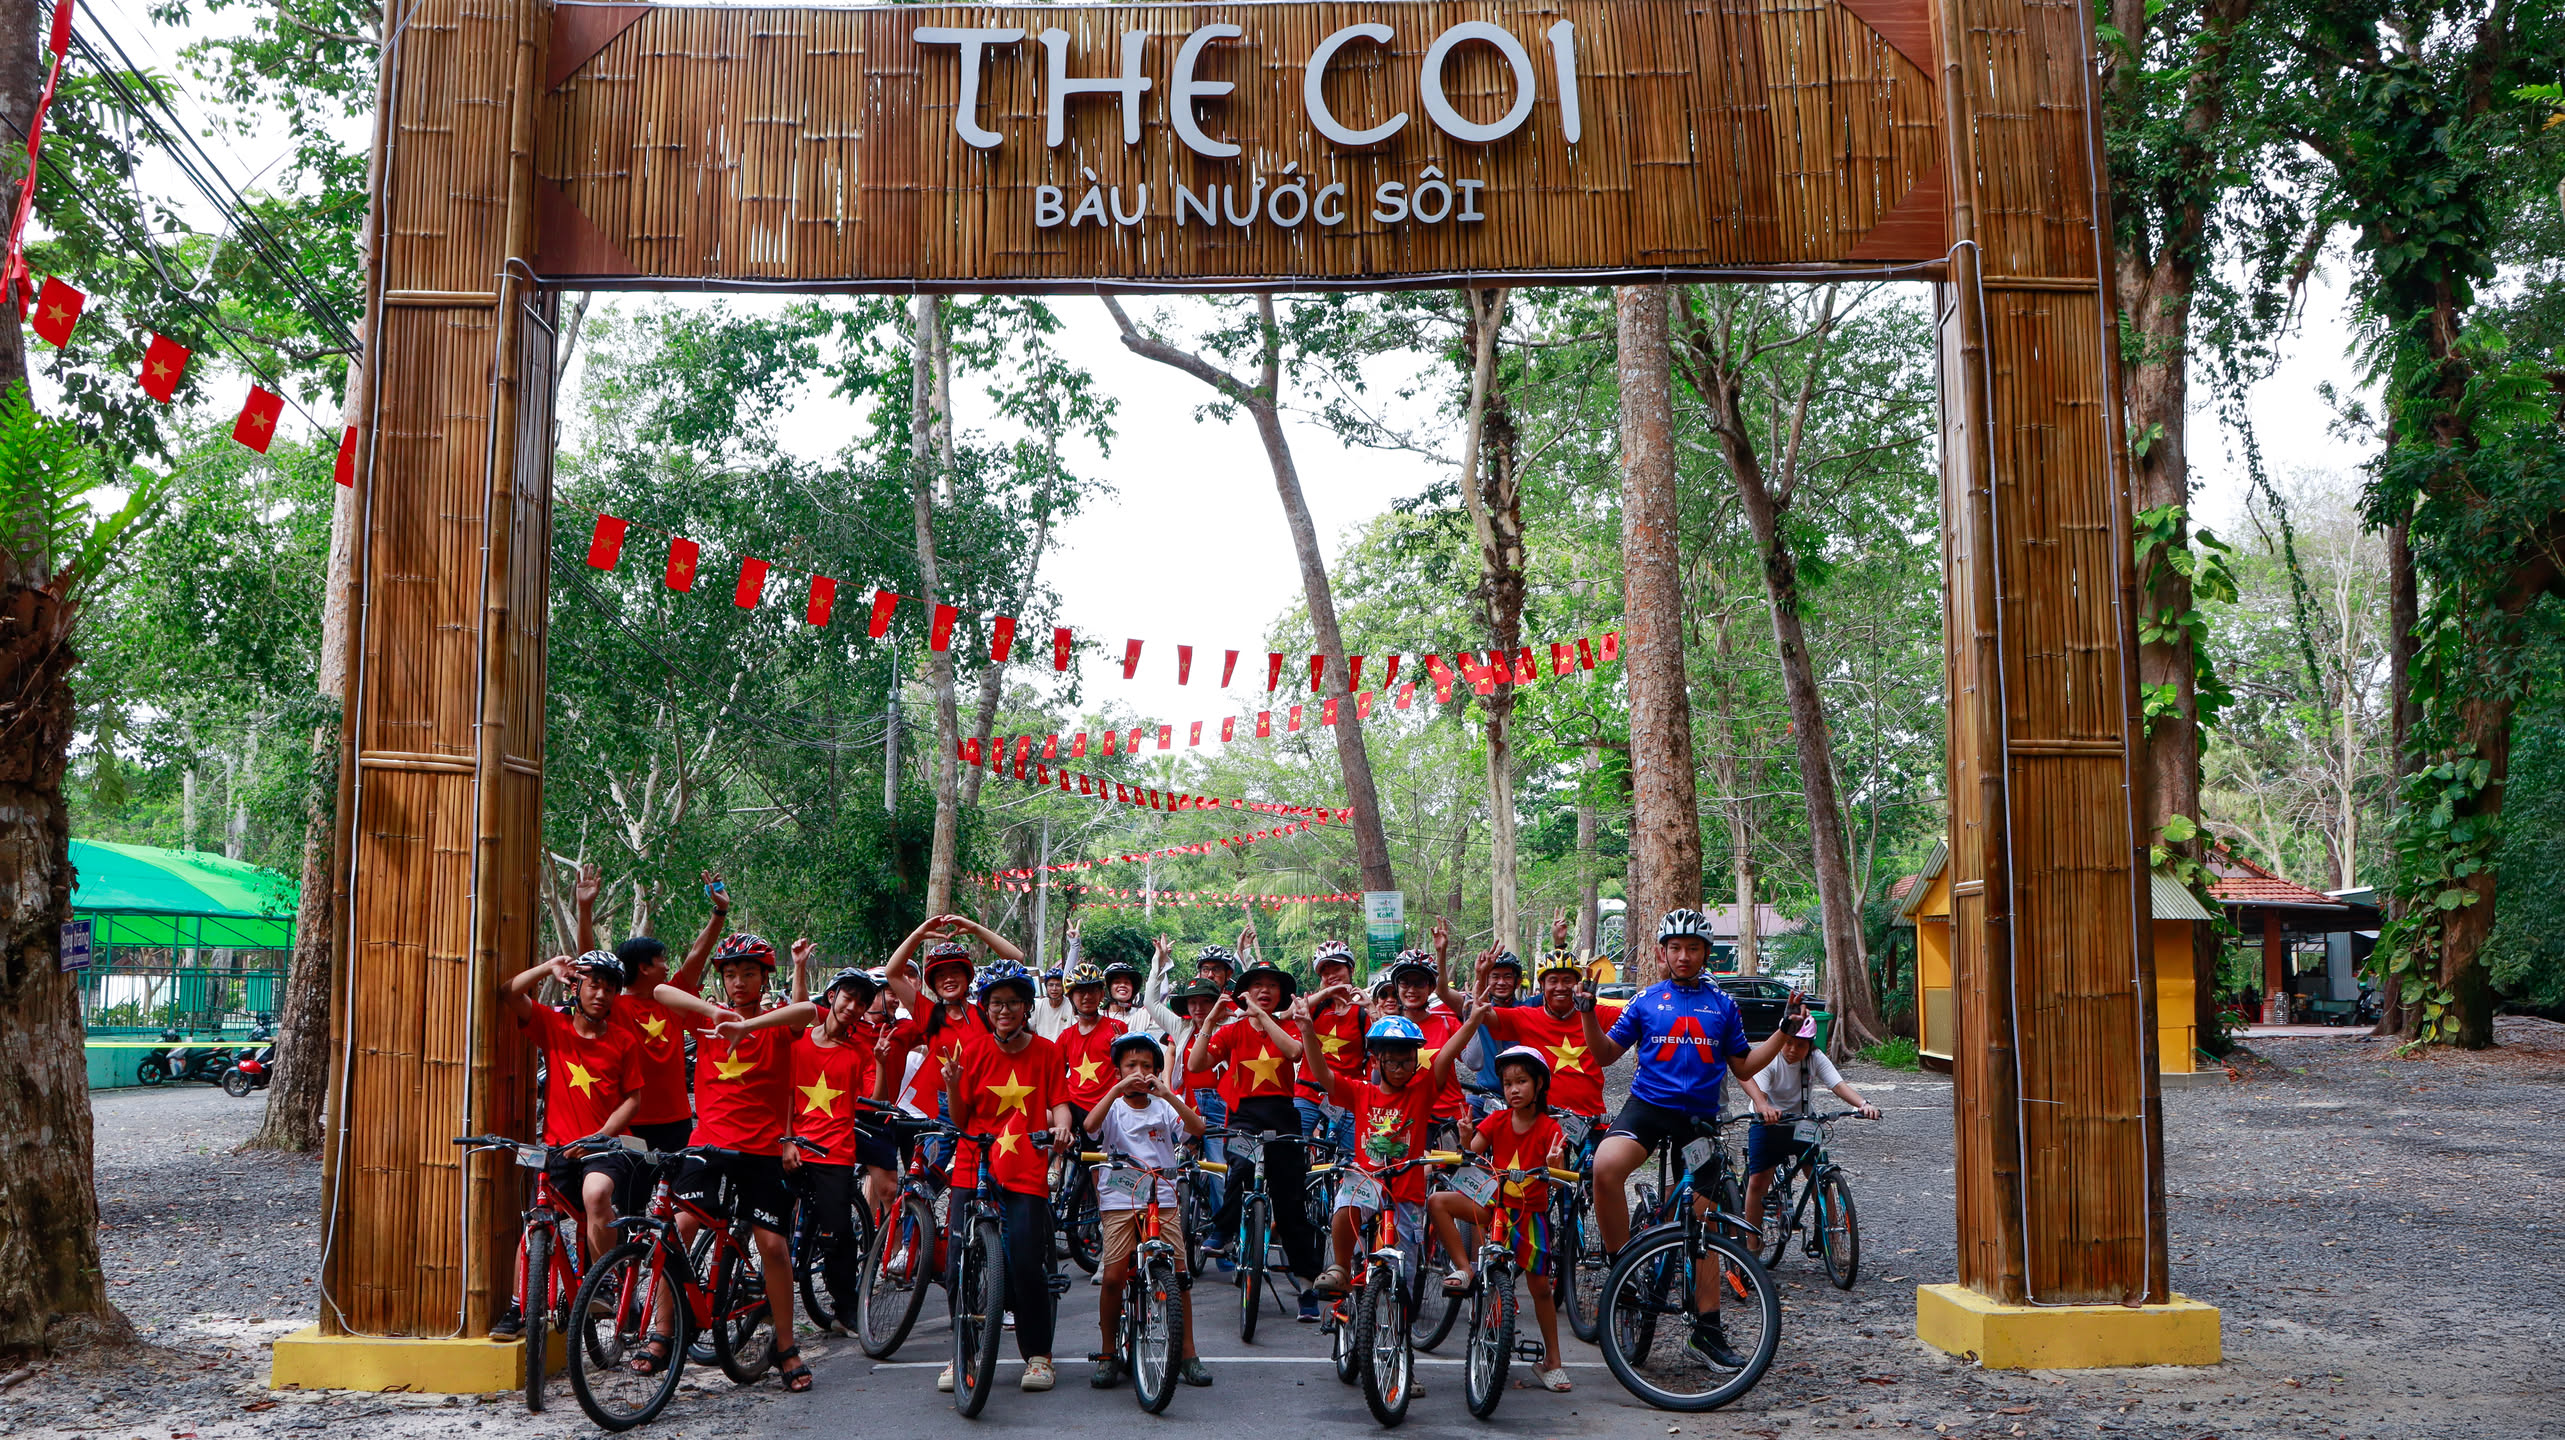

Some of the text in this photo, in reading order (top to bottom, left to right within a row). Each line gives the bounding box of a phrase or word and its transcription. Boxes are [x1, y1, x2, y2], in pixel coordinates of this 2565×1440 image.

[913, 19, 1581, 158] THE COI
[1034, 161, 1486, 229] BÀU NƯỚC SÔI
[1651, 1035, 1720, 1048] GRENADIER
[1351, 1185, 1371, 1198] S004
